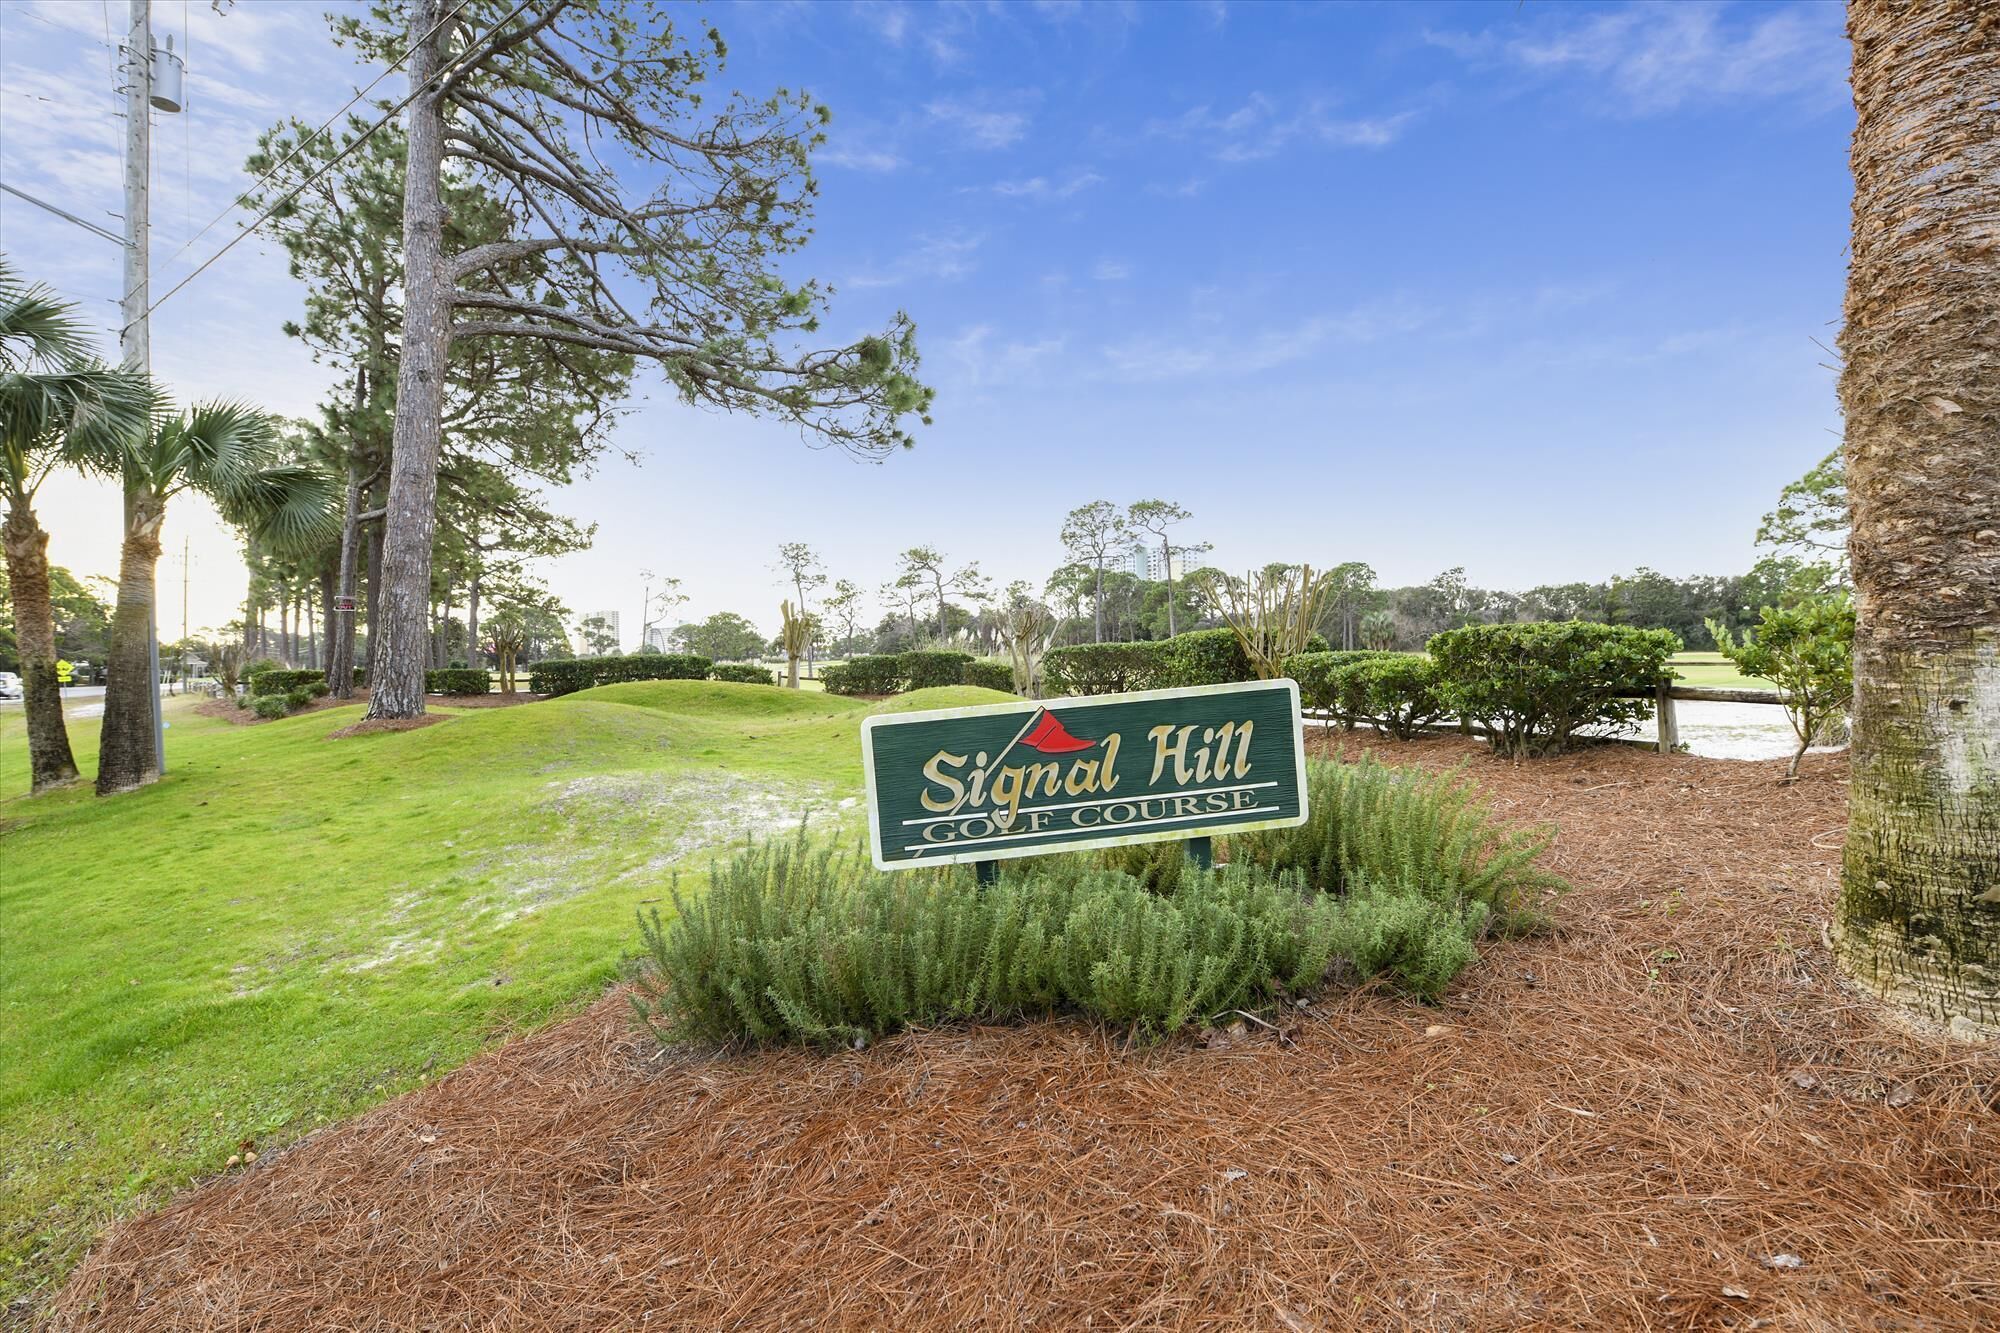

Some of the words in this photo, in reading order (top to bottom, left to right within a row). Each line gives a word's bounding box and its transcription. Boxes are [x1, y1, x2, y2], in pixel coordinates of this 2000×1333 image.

[920, 732, 1121, 828] Signal
[1148, 720, 1254, 786] Hill
[1071, 790, 1259, 826] COURSE
